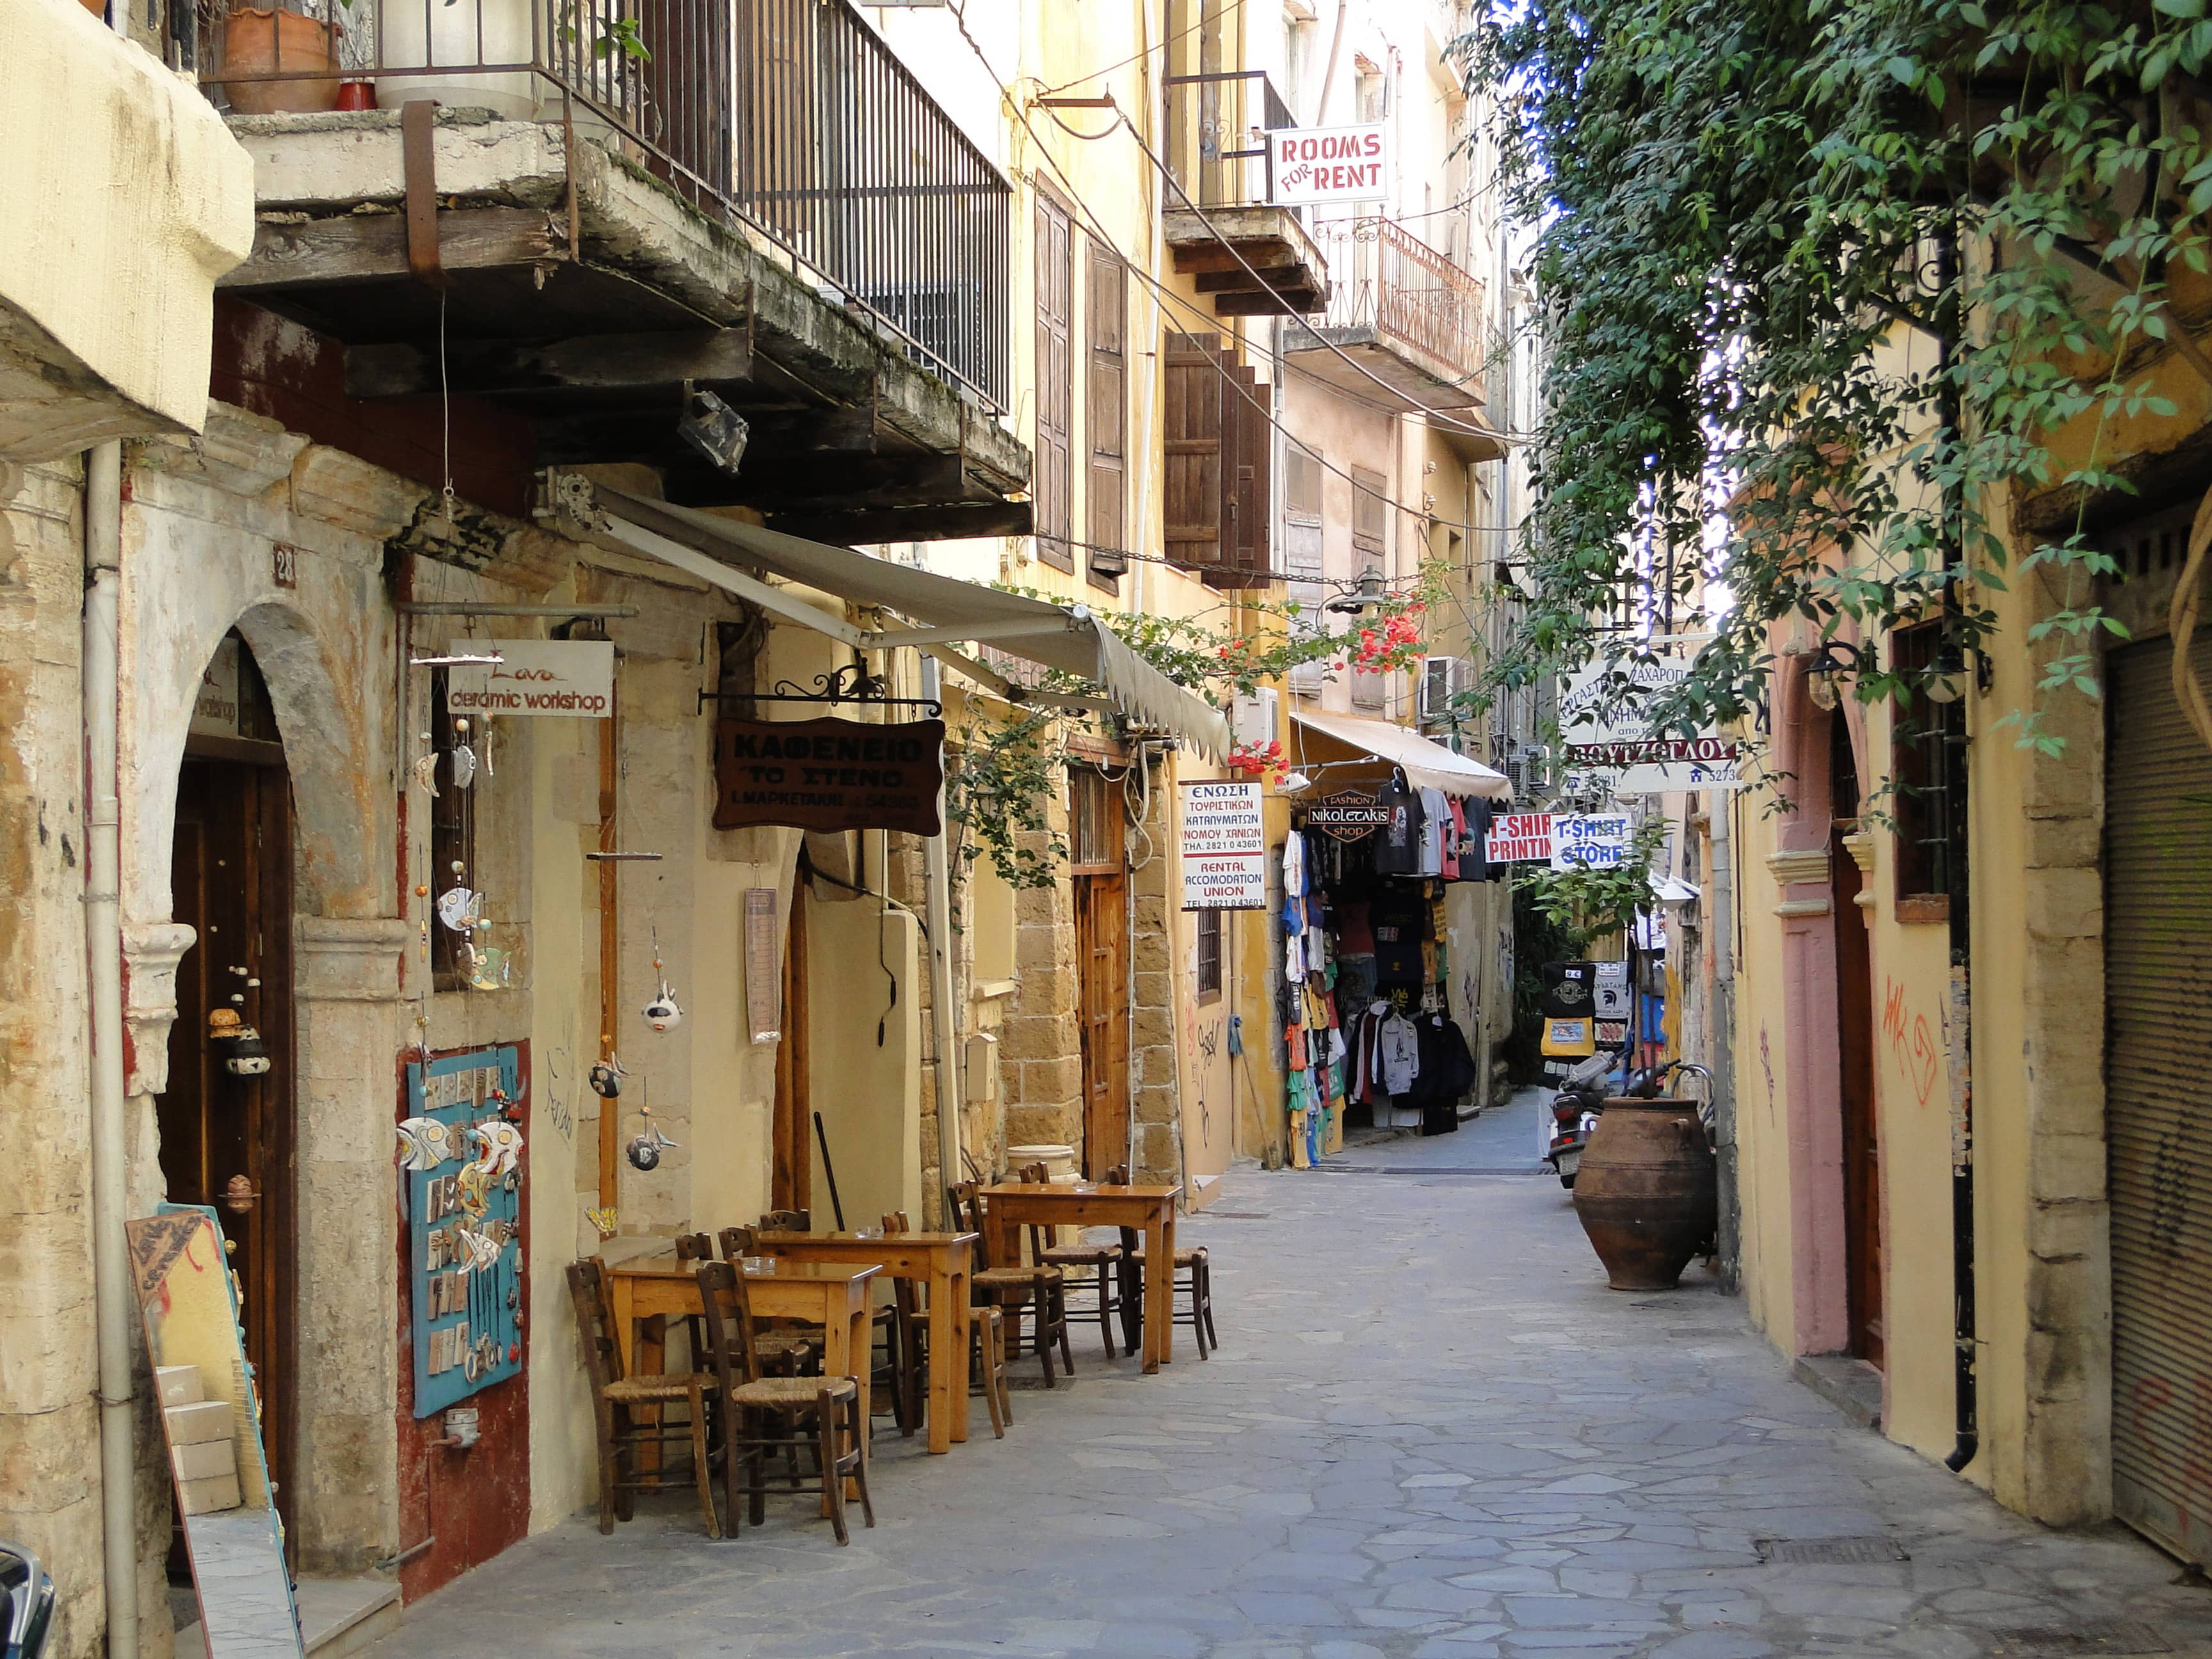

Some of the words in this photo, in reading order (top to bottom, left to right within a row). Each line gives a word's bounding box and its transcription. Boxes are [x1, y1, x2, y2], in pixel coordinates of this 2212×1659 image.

[1282, 134, 1381, 162] ROOMS
[1281, 163, 1313, 192] FOR
[1314, 163, 1381, 190] RENT
[277, 549, 293, 582] 28
[451, 689, 521, 709] ceramic
[524, 690, 605, 714] workshop
[734, 733, 923, 763] ΚΑΦΕΝΕΙΟ
[1192, 785, 1249, 798] ΕΝΩΣΗ
[1189, 800, 1253, 812] ΤΟΥΡΙΣΤΙΚΩΝ
[1334, 826, 1364, 837] shop
[1489, 813, 1551, 839] T-SHIR
[1184, 830, 1221, 840] ΝΟΜΟΥ
[1226, 828, 1261, 838] ΧΑΝΙΩΝ
[1184, 842, 1205, 851] ΤΗΛ.
[1206, 841, 1226, 849] 2821
[1230, 840, 1235, 849] 0
[1237, 840, 1262, 848] 43601
[1489, 837, 1551, 861] PRINTIN
[1561, 845, 1623, 865] STORE
[1201, 862, 1246, 872] RENTAL
[1185, 874, 1262, 885] ACCOMODATION
[1203, 886, 1244, 897] UNION
[1238, 899, 1263, 907] 43601
